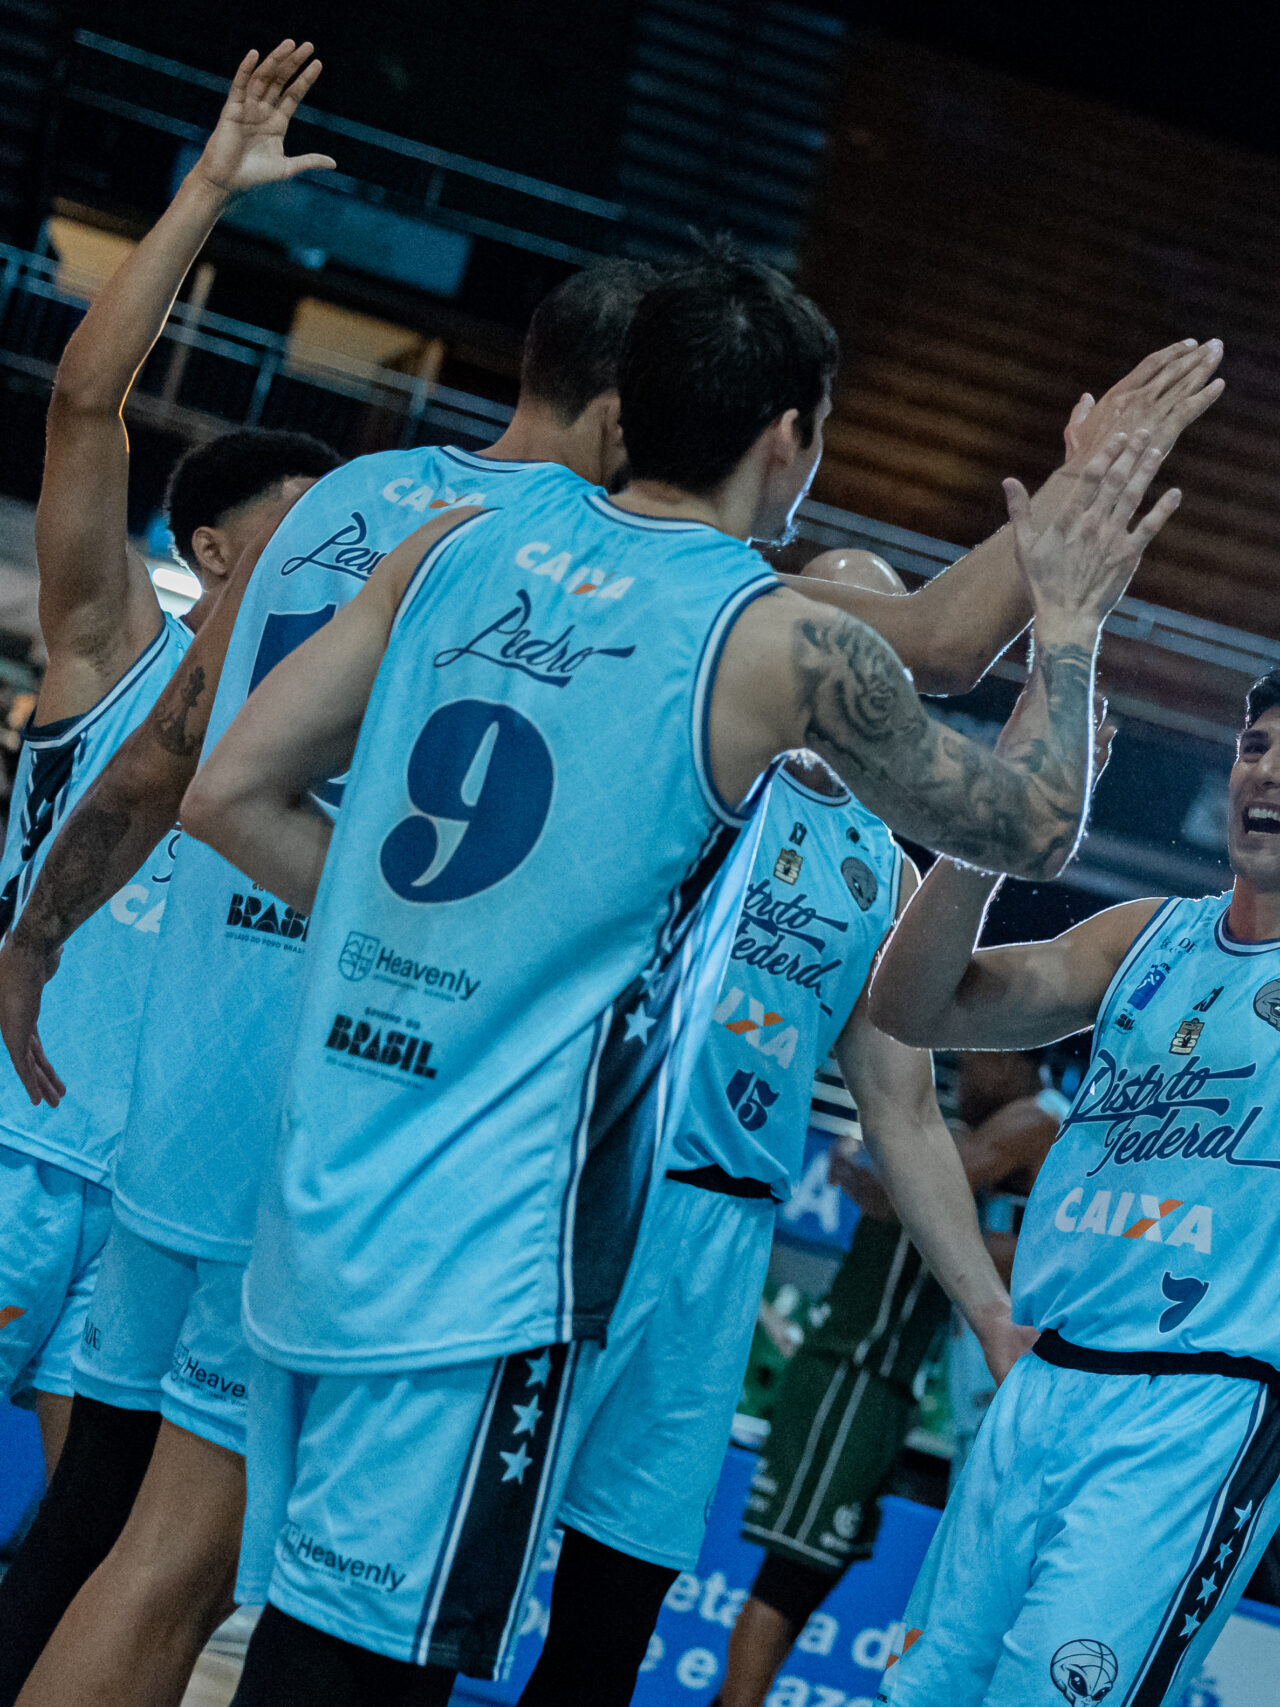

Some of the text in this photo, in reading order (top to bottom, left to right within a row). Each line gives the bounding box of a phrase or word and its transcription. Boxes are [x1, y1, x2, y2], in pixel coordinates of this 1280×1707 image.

[433, 589, 636, 688] Pedro
[379, 698, 554, 905] 9
[376, 947, 481, 1001] Heavenly
[325, 1014, 438, 1080] BRASIL
[712, 986, 799, 1069] IXA
[727, 1069, 780, 1131] 15
[1057, 1049, 1256, 1130] Distrito
[1055, 1187, 1213, 1255] CAIXA
[1159, 1271, 1210, 1333] 7
[184, 1356, 247, 1398] Heave
[297, 1534, 406, 1593] Heavenly
